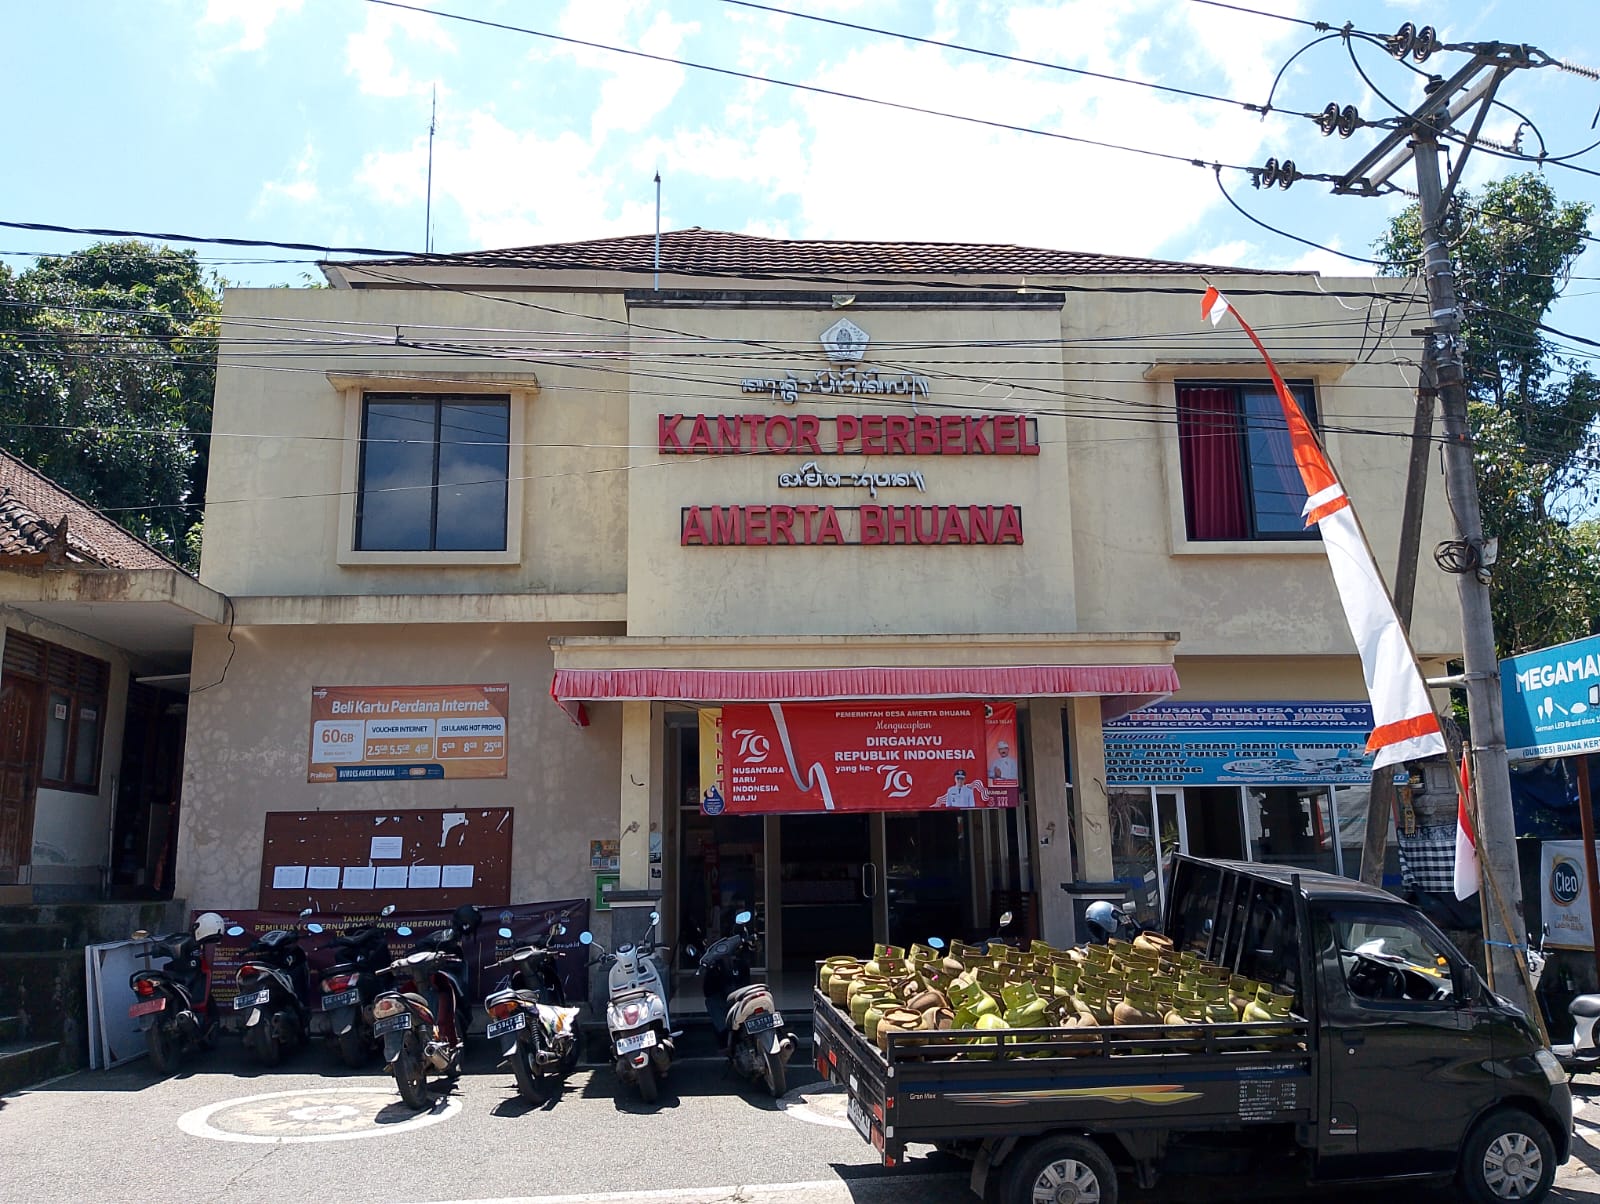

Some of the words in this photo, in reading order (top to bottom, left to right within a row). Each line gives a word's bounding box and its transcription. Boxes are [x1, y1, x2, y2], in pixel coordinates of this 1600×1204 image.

[659, 413, 822, 455] KANTOR
[836, 414, 1041, 455] PERBEKEL
[682, 505, 845, 546] AMERTA
[860, 504, 1024, 545] BHUANA
[332, 700, 355, 714] Beli
[356, 700, 389, 714] Kartu
[391, 699, 440, 713] Perdana
[442, 698, 490, 712] Internet
[939, 709, 971, 717] BHUANA
[1294, 713, 1346, 721] JAYA
[400, 725, 428, 733] INTERNET
[481, 723, 502, 731] PROMO
[875, 720, 932, 733] Mengucapkan
[1555, 721, 1565, 730] LED
[321, 728, 354, 744] 60GB
[1103, 732, 1167, 742] elayani
[731, 728, 770, 763] 79
[866, 735, 942, 747] DIRGAHAYU
[1184, 742, 1276, 751] SEHARI-HARI
[1279, 742, 1358, 750] (SEMBAKO)
[1522, 744, 1556, 759] (BUMDES)
[1557, 741, 1582, 752] BUANA
[1583, 739, 1600, 749] KER
[834, 749, 900, 762] REPUBLIK
[904, 748, 976, 761] INDONESIA
[1105, 758, 1188, 766] OTOCOPY
[732, 766, 785, 774] NUSANTARA
[1106, 766, 1204, 774] AMINATING
[732, 776, 756, 784] BARU
[835, 764, 857, 774] yang
[859, 764, 874, 773] ke-
[876, 764, 913, 798] 79
[732, 784, 779, 793] INDONESIA
[732, 794, 757, 802] MAJU
[1555, 871, 1578, 893] Cleo
[344, 914, 382, 923] TAHAPAN
[303, 922, 350, 932] GERNUR
[400, 919, 447, 929] GUBERNUR
[909, 1092, 923, 1100] Gran
[924, 1092, 936, 1100] Max
